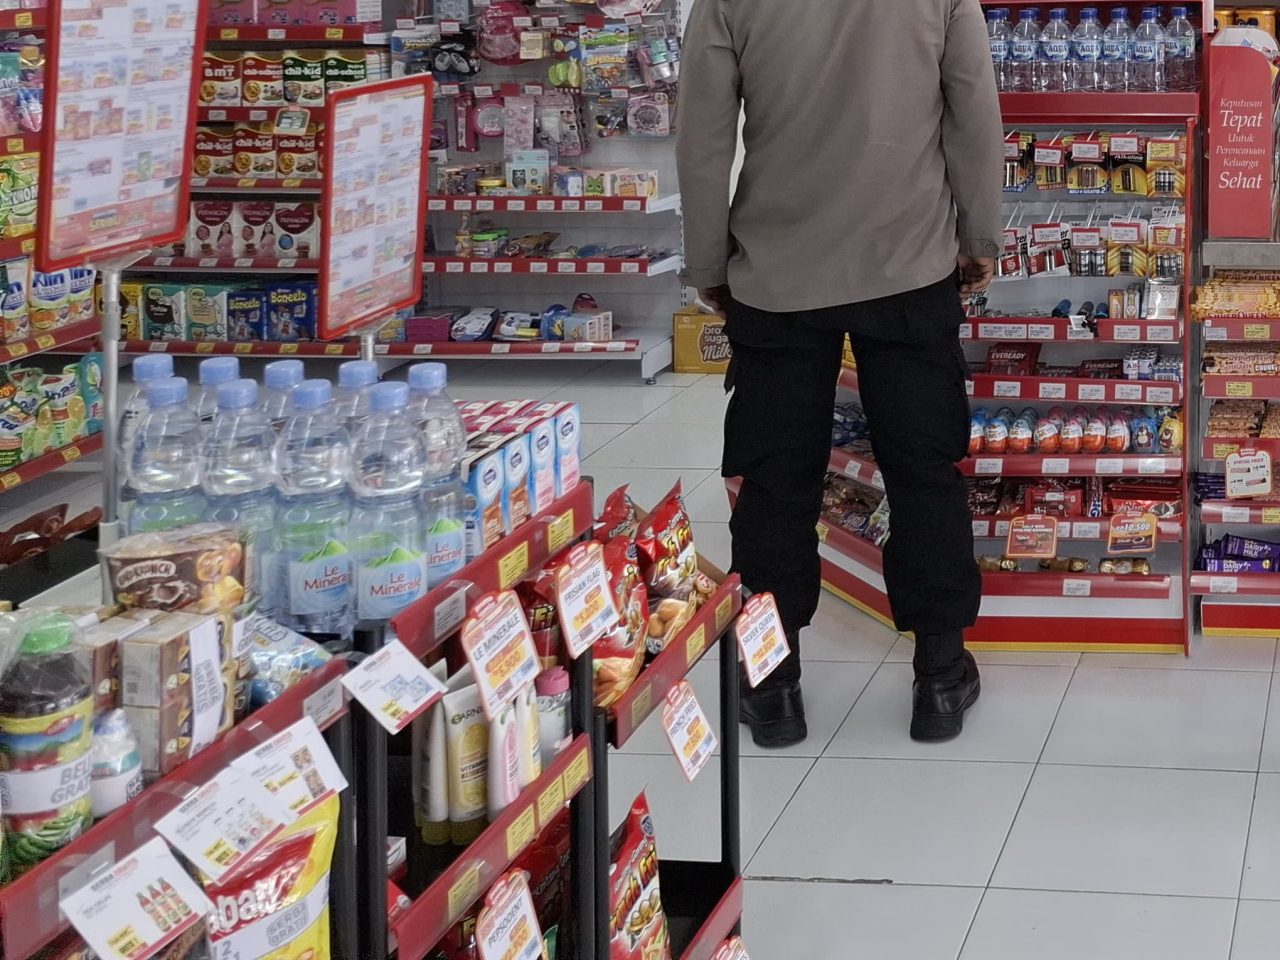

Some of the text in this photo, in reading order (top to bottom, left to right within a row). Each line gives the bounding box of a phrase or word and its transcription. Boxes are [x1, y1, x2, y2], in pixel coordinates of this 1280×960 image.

[1049, 44, 1068, 53] AQUA
[205, 69, 234, 77] BMT
[1220, 97, 1263, 110] Keputusan
[1220, 109, 1264, 131] Tepat
[1228, 133, 1255, 143] Untuk
[1215, 145, 1266, 155] Perencanaan
[1222, 157, 1258, 169] Keluarga
[1218, 171, 1263, 189] Sehat
[704, 335, 728, 344] suga
[991, 352, 1026, 361] EVEREADY
[435, 541, 449, 553] Le
[427, 547, 464, 565] inerale
[324, 565, 339, 577] Le
[389, 571, 405, 583] Le
[304, 573, 349, 590] Minera
[565, 567, 601, 602] FRISIAN FLAG
[743, 613, 775, 645] SILVER QUEEN
[473, 613, 521, 661] LE MINERALE
[670, 700, 697, 738] FRENCH FRIES
[488, 896, 523, 949] PEPSODENT
